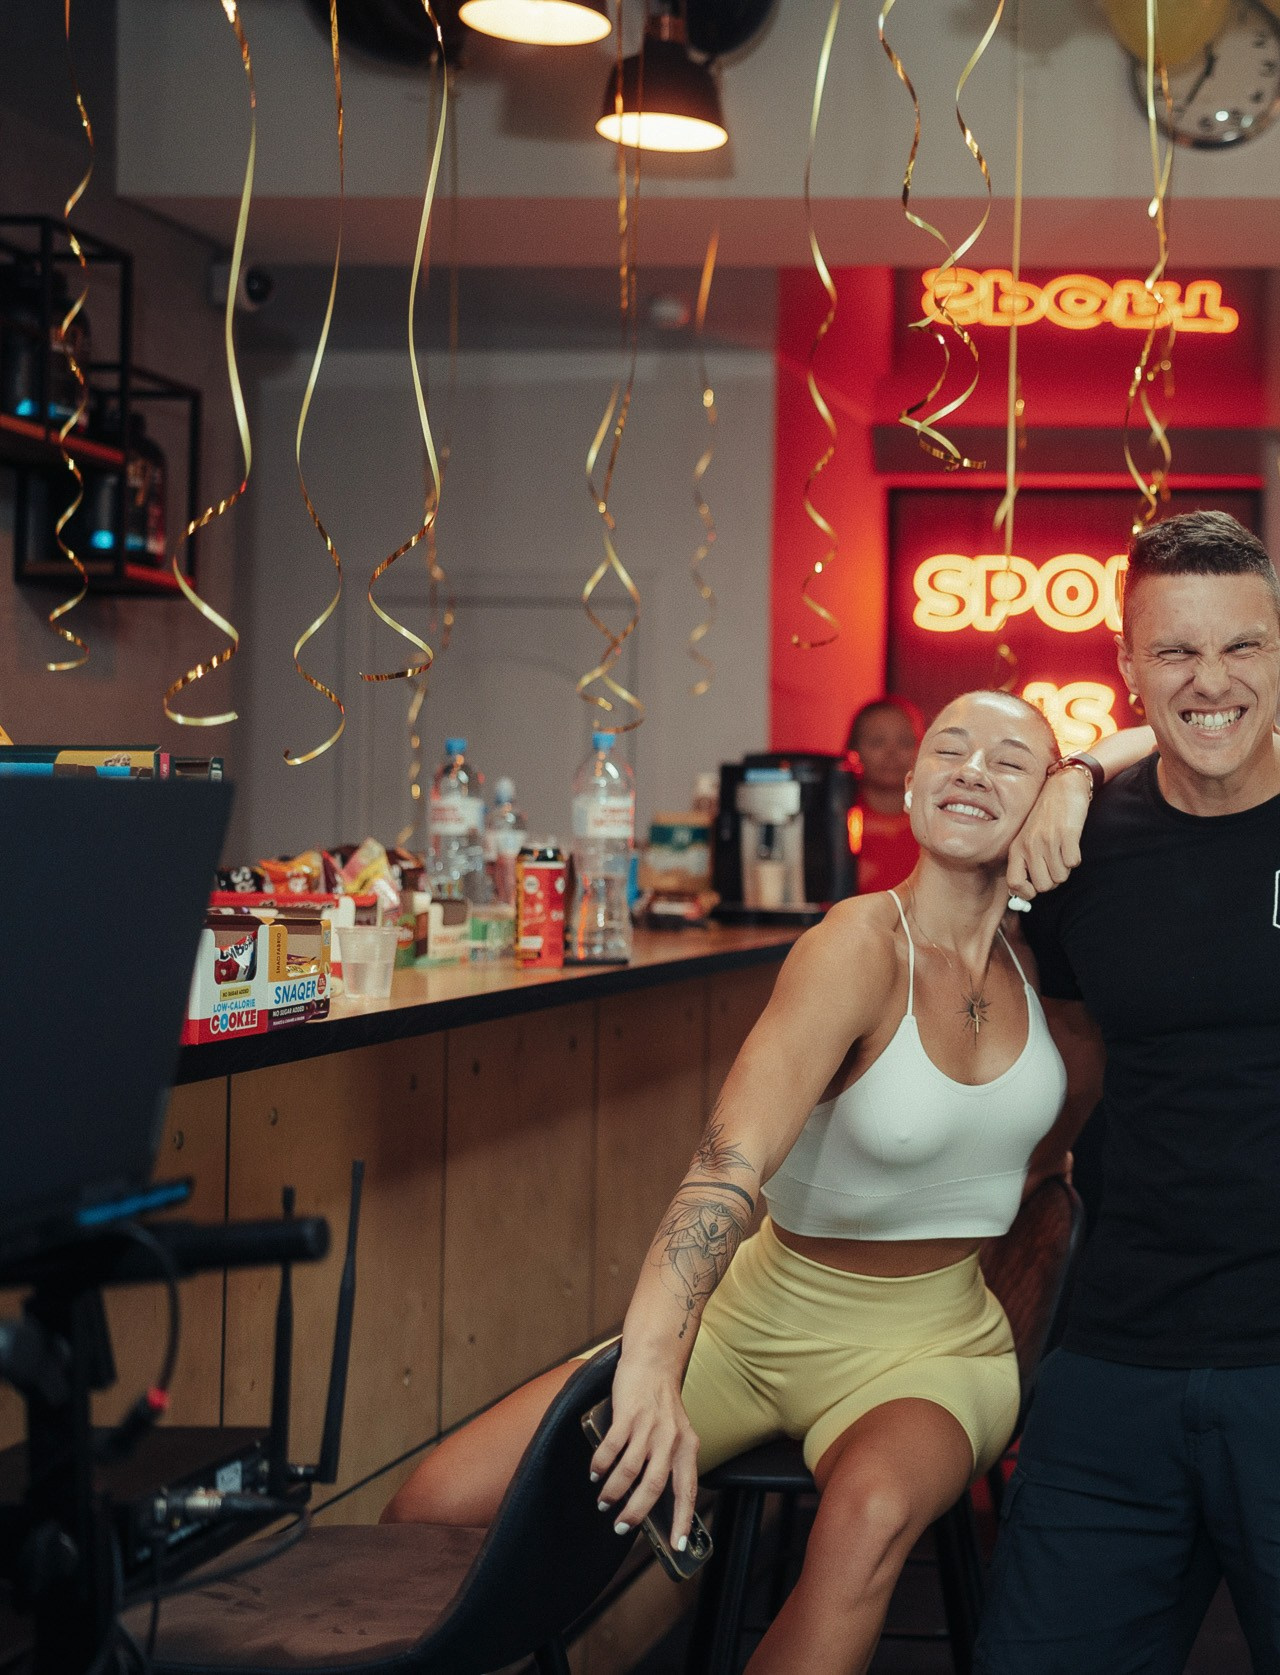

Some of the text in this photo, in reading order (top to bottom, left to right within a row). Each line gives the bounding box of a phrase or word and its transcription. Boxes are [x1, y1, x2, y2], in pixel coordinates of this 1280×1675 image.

[913, 553, 1129, 632] SPO
[274, 980, 317, 1004] SNAQER
[213, 999, 256, 1013] LOW-CALORIE
[210, 1009, 258, 1034] COOKIE
